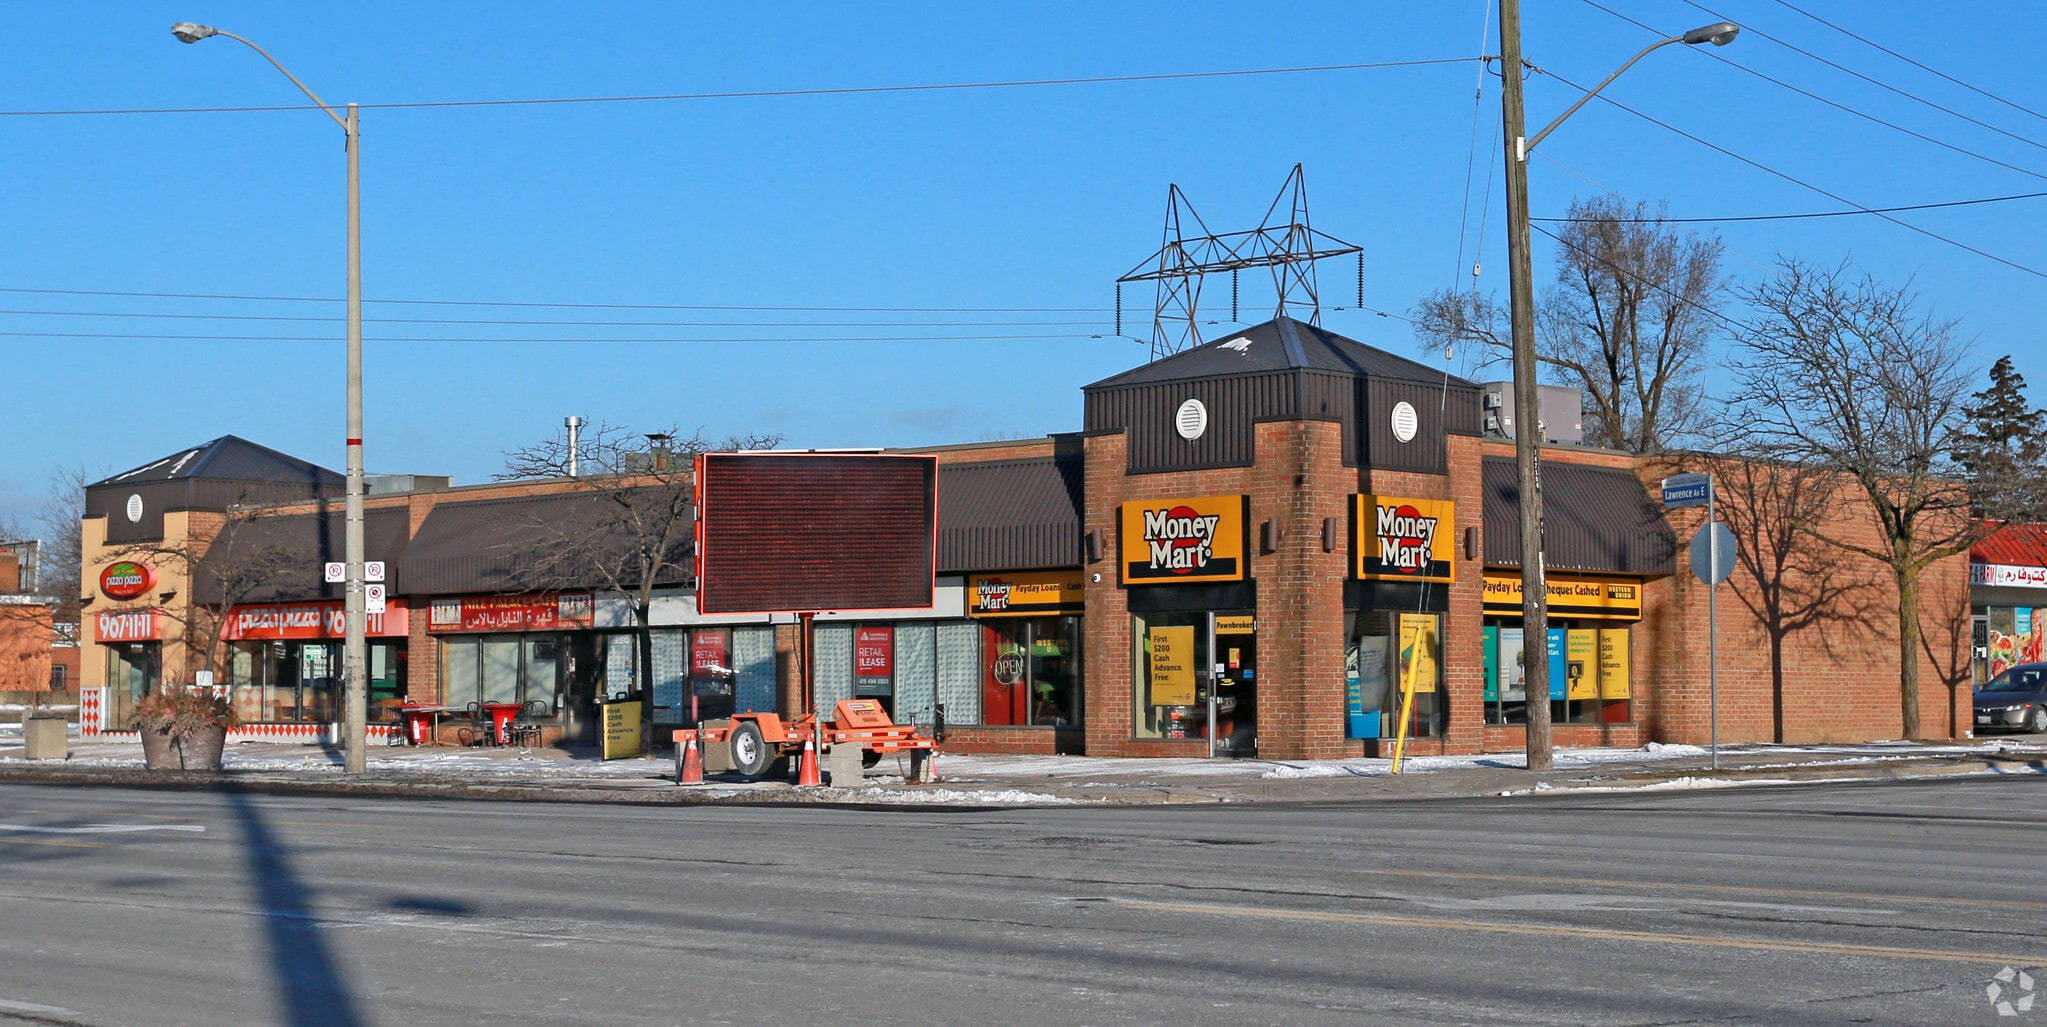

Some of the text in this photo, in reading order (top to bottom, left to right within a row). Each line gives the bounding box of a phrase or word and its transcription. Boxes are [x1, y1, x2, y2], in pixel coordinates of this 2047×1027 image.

[1665, 489, 1693, 500] Lawrence
[1701, 486, 1705, 497] E
[1144, 510, 1219, 547] Money
[1377, 507, 1437, 548] Money
[1150, 540, 1207, 569] Mart
[1381, 538, 1428, 568] Mart
[106, 575, 142, 588] pizza pizza
[978, 580, 1011, 597] Money
[1016, 583, 1039, 594] Payday
[1041, 583, 1060, 591] Loans
[1483, 581, 1510, 594] Payday
[1546, 583, 1573, 597] heques
[1575, 584, 1600, 596] Cashed
[465, 594, 557, 609] NILE PALACE CAFE
[980, 595, 1008, 609] Mart
[238, 608, 278, 636] pizza
[279, 607, 320, 635] pizza
[1216, 620, 1252, 629] Pawnbroker
[695, 650, 719, 659] RETAIL
[859, 647, 884, 657] RETAIL
[1153, 644, 1170, 653] $200
[1153, 654, 1170, 662] Cash
[996, 659, 1023, 675] OPEN
[1154, 673, 1169, 681] Free
